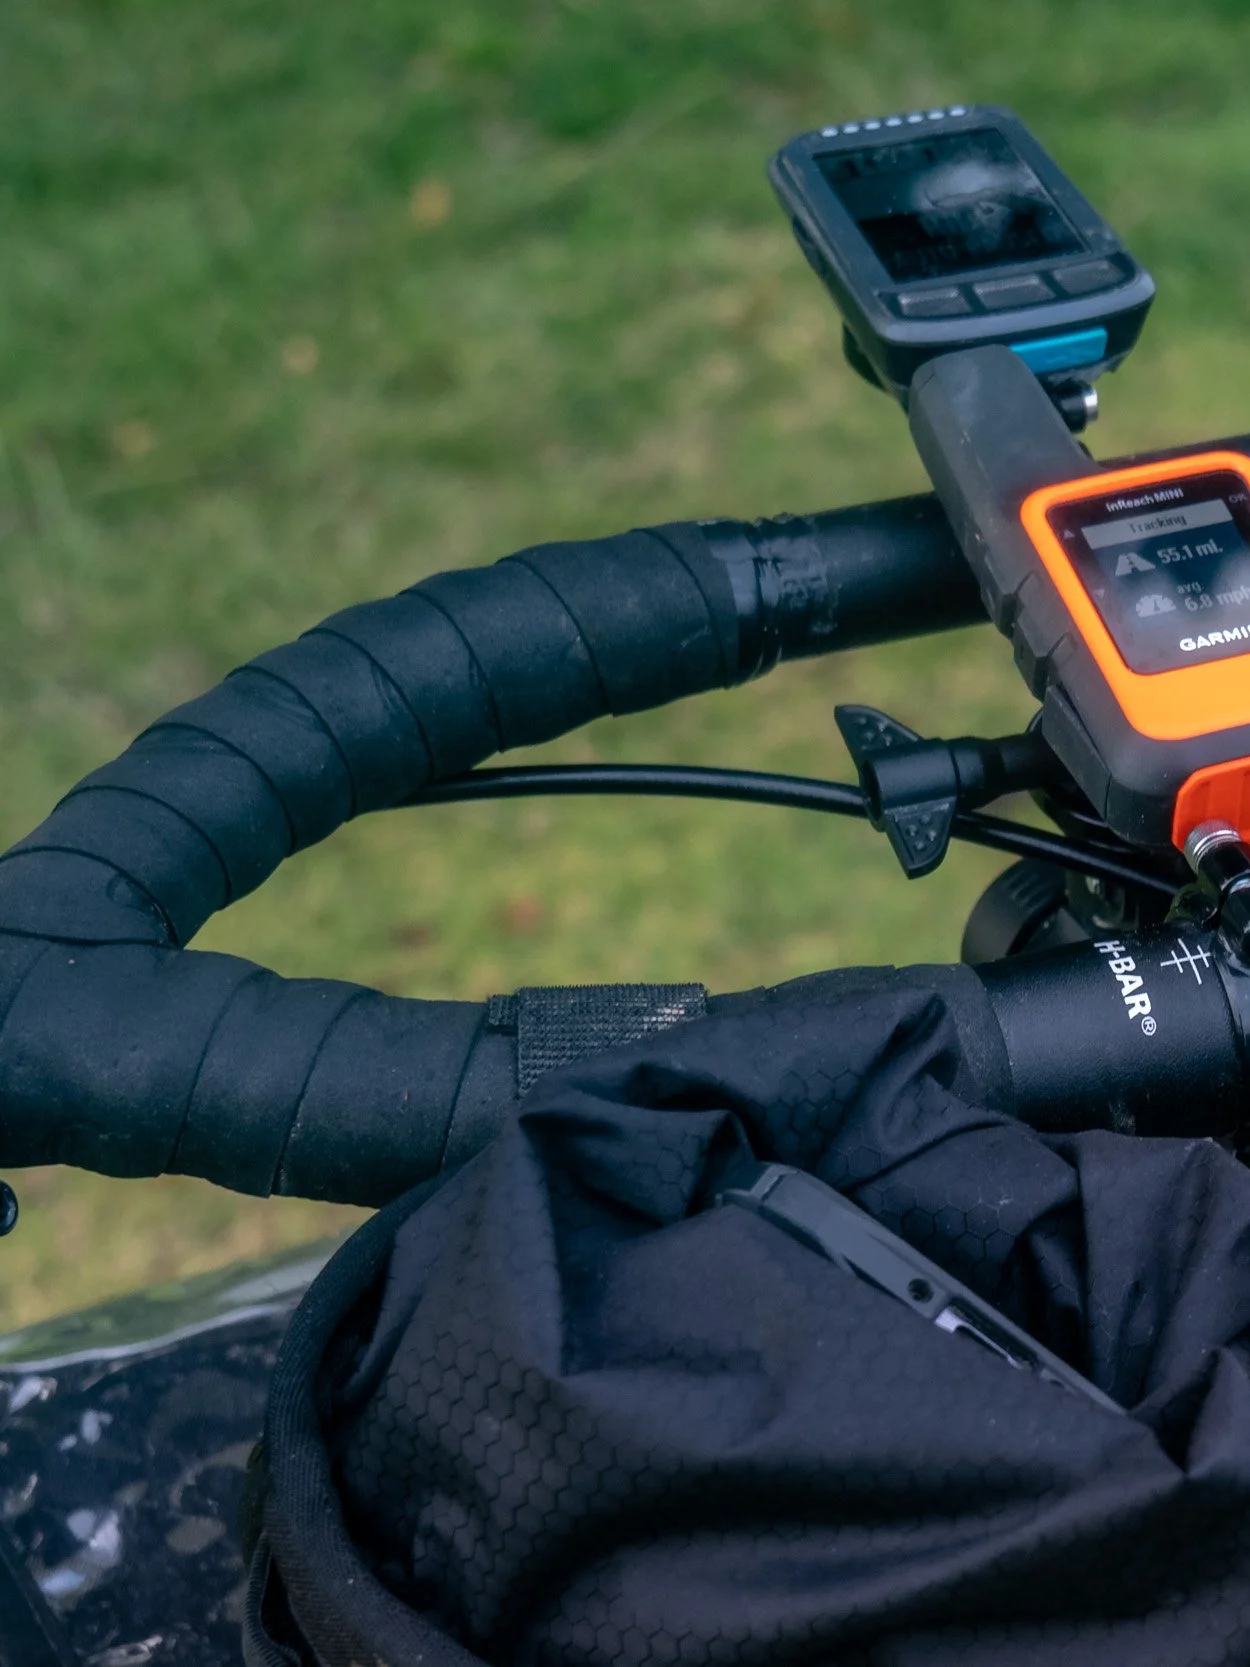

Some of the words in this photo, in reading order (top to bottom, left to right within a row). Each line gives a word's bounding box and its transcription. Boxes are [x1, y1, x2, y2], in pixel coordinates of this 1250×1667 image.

[1153, 487, 1184, 504] MINI
[1129, 514, 1187, 534] Tracking
[1157, 544, 1194, 564] 55.1
